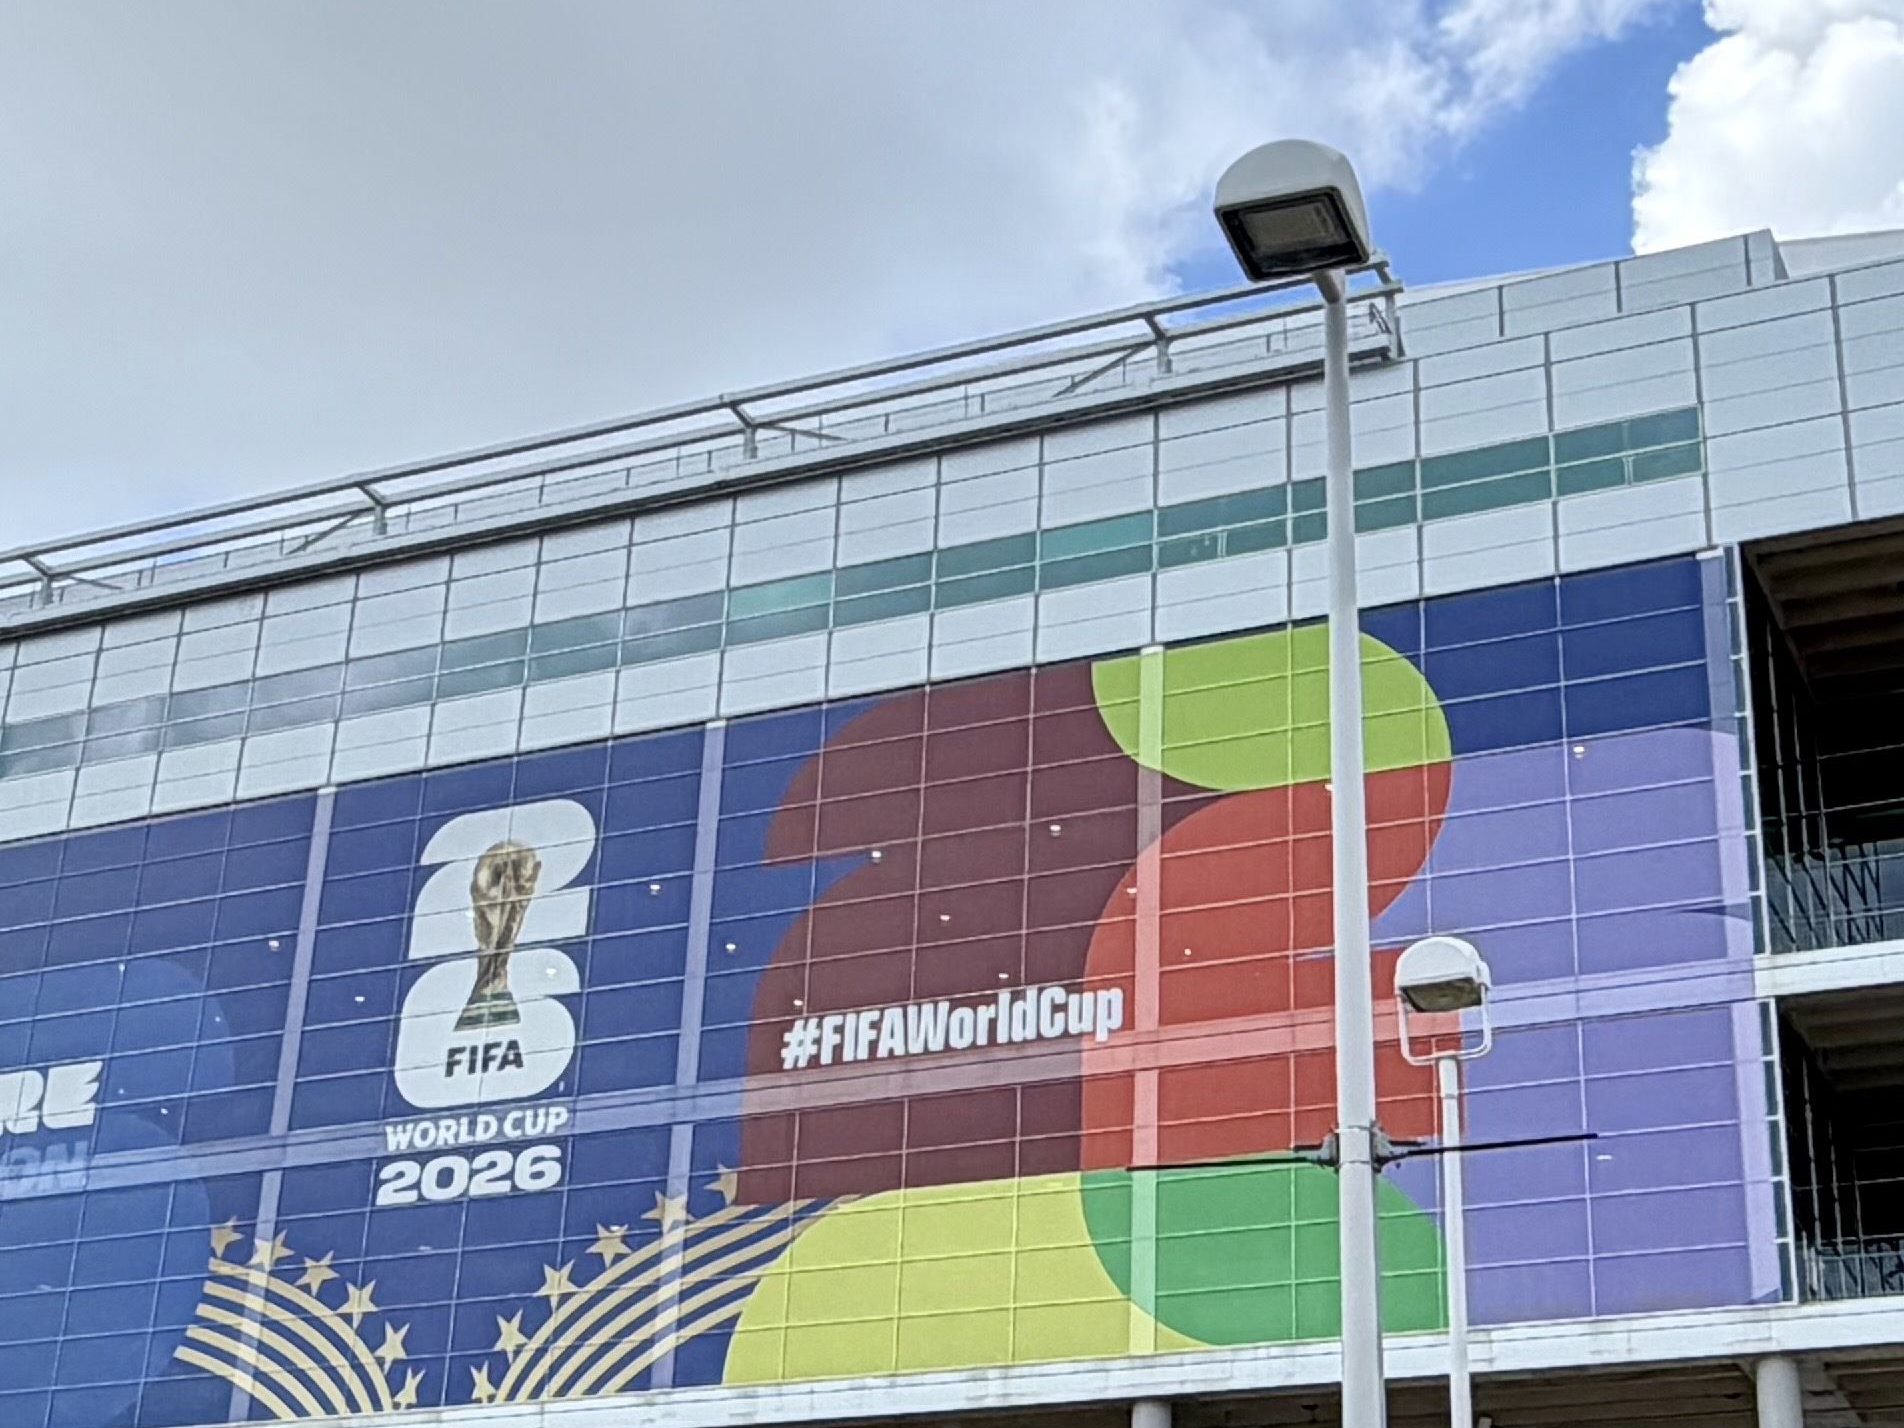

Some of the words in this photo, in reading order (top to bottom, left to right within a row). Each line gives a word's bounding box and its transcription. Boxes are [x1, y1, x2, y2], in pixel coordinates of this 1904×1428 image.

[781, 987, 1123, 1070] #FIFAWorldCup
[444, 1039, 524, 1078] FIFA
[385, 1114, 498, 1152] WORLD
[503, 1106, 569, 1139] CUP
[375, 1144, 563, 1206] 2026
